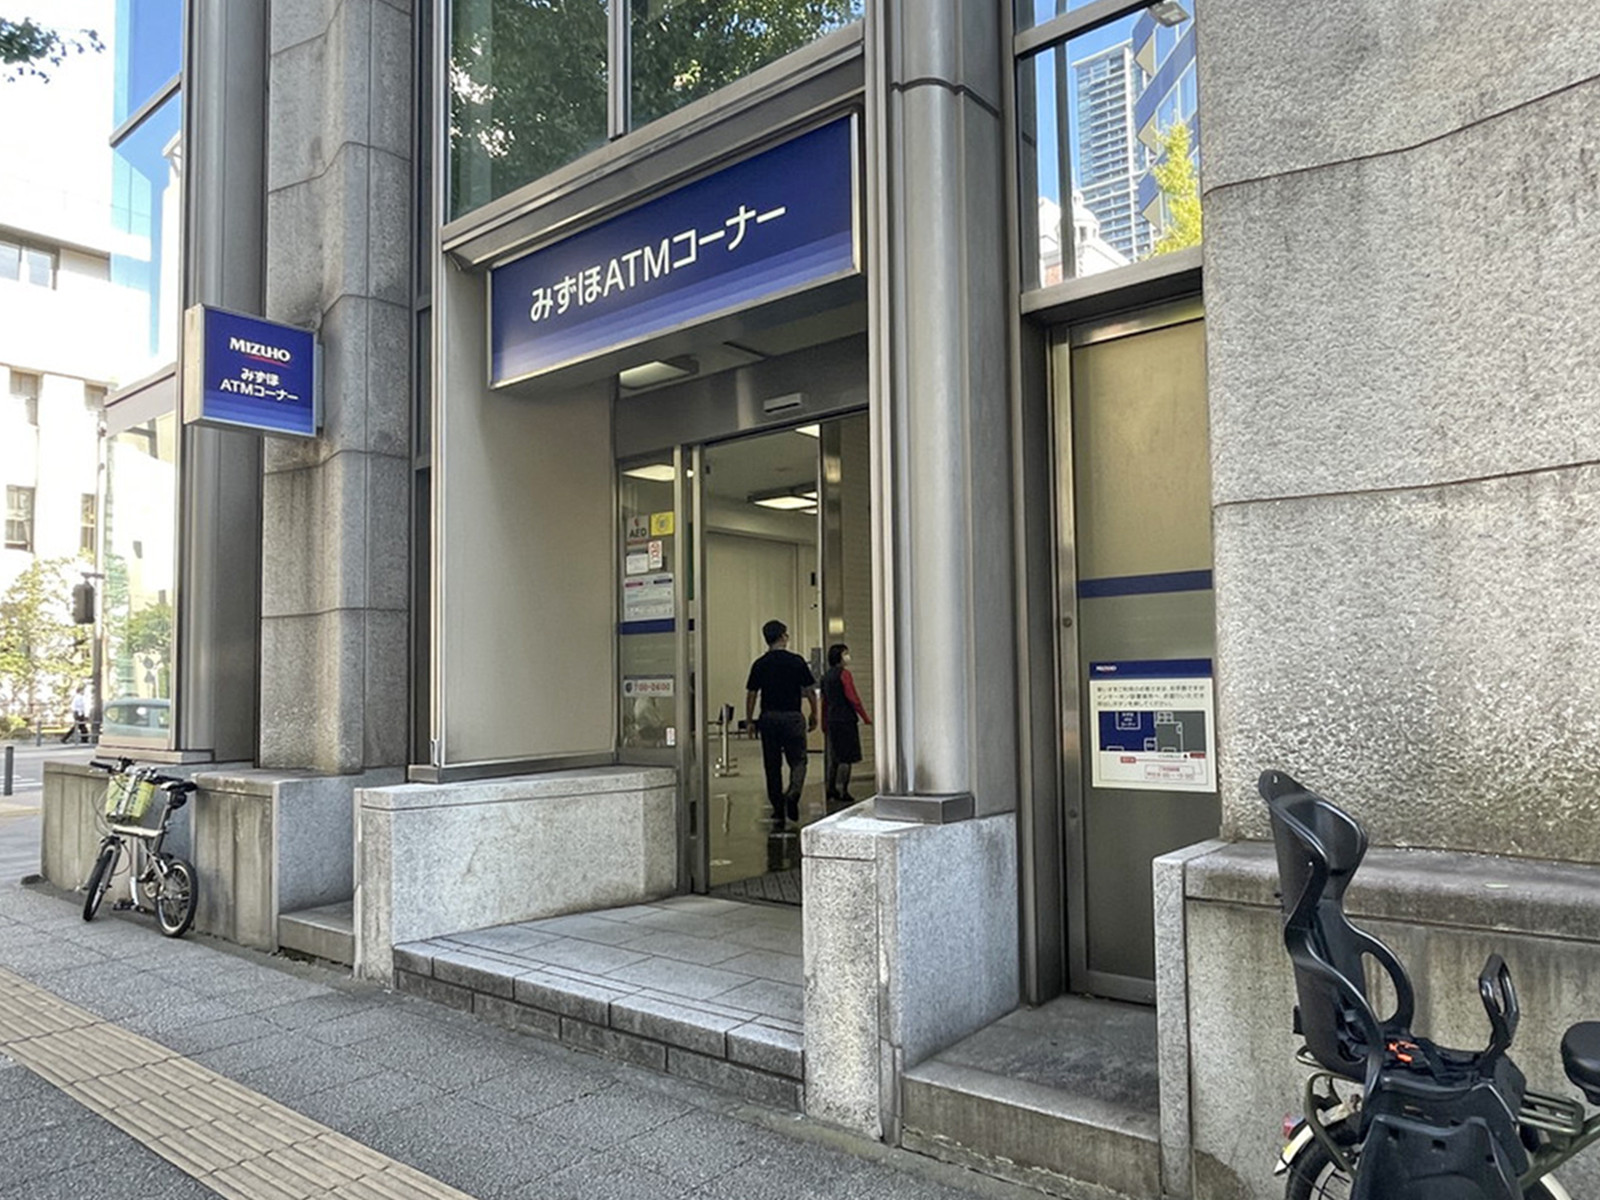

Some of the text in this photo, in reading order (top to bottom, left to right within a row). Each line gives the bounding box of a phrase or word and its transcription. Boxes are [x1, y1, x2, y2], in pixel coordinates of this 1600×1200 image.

[530, 205, 786, 322] みずほATMコーナー
[229, 337, 291, 361] MIZUHO
[240, 367, 279, 386] みずほ
[220, 378, 299, 401] ATMコーナー
